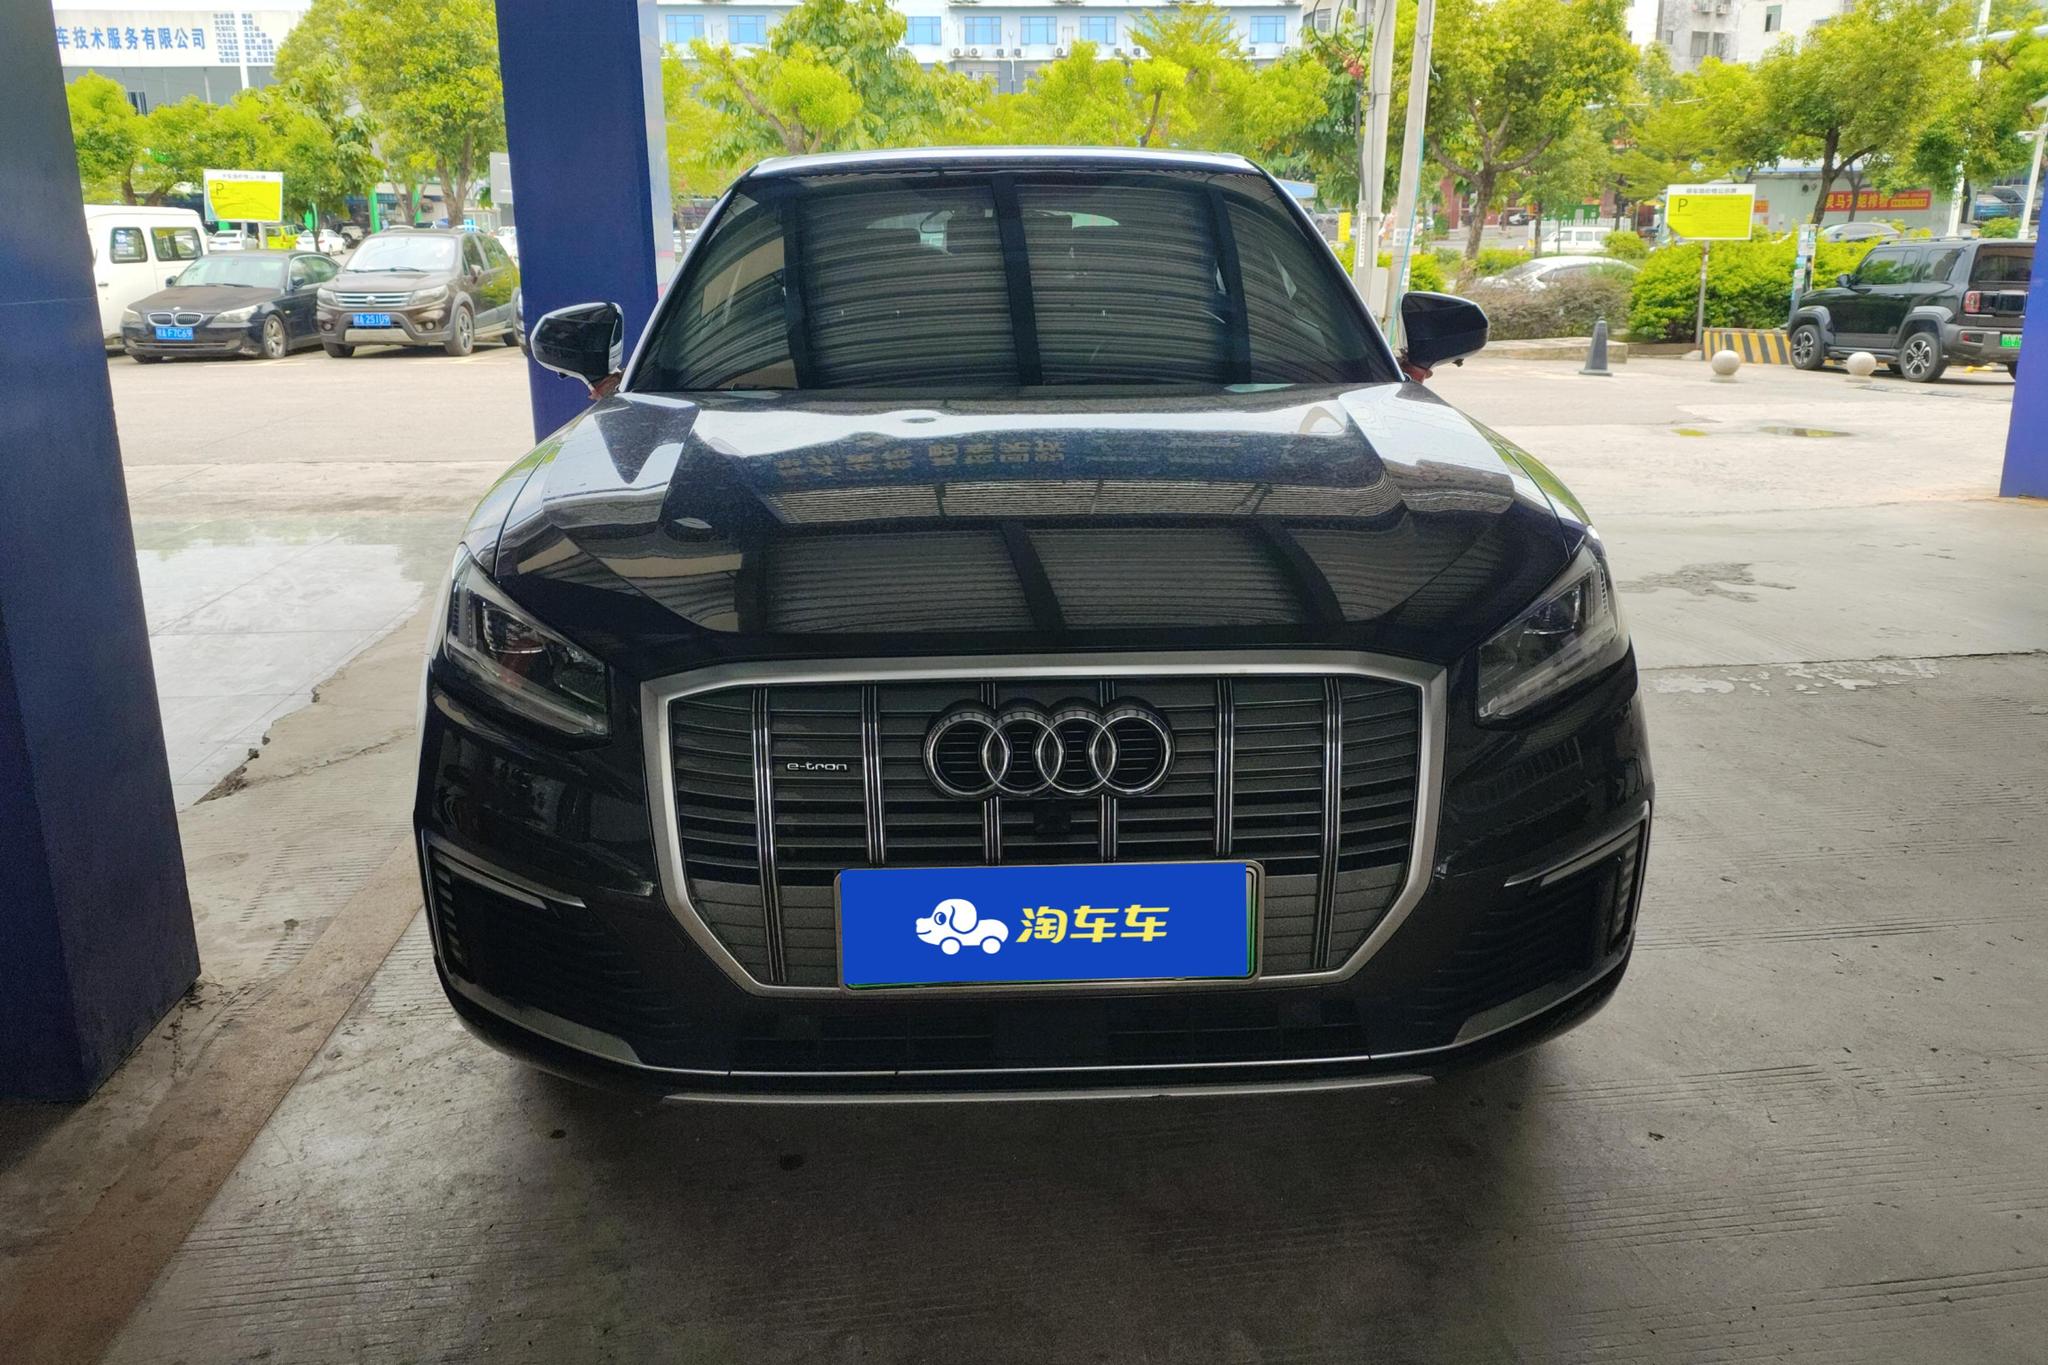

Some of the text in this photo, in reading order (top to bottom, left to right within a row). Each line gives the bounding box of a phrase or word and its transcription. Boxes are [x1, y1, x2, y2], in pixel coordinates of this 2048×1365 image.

[56, 26, 206, 50] 车技术服务有限公司
[215, 183, 225, 196] P
[1677, 198, 1689, 213] P
[786, 761, 848, 771] e-tron
